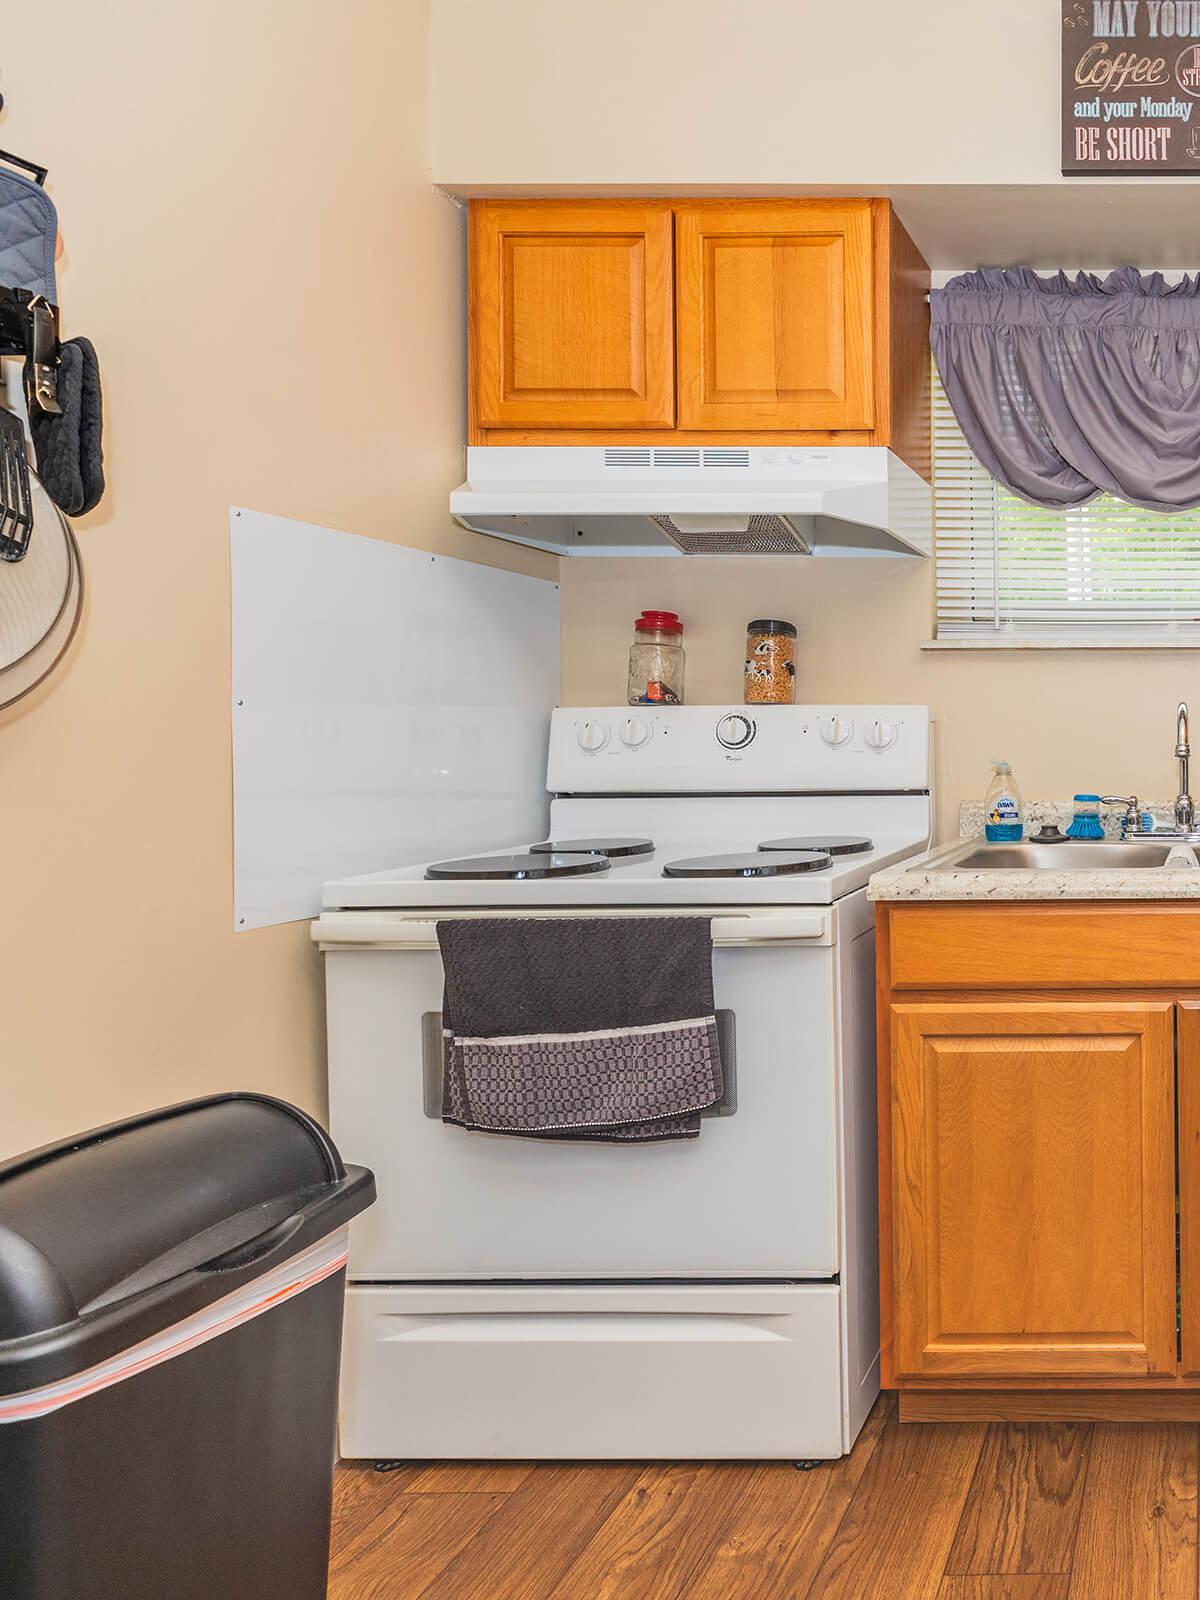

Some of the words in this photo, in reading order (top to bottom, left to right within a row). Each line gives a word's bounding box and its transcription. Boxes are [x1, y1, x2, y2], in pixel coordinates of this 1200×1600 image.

[1092, 0, 1139, 37] MAY
[1074, 42, 1170, 92] Coffee
[1074, 97, 1100, 118] and
[1104, 101, 1137, 122] your
[1140, 97, 1193, 122] Monday
[1075, 127, 1100, 161] BE
[1106, 127, 1171, 161] SHORT
